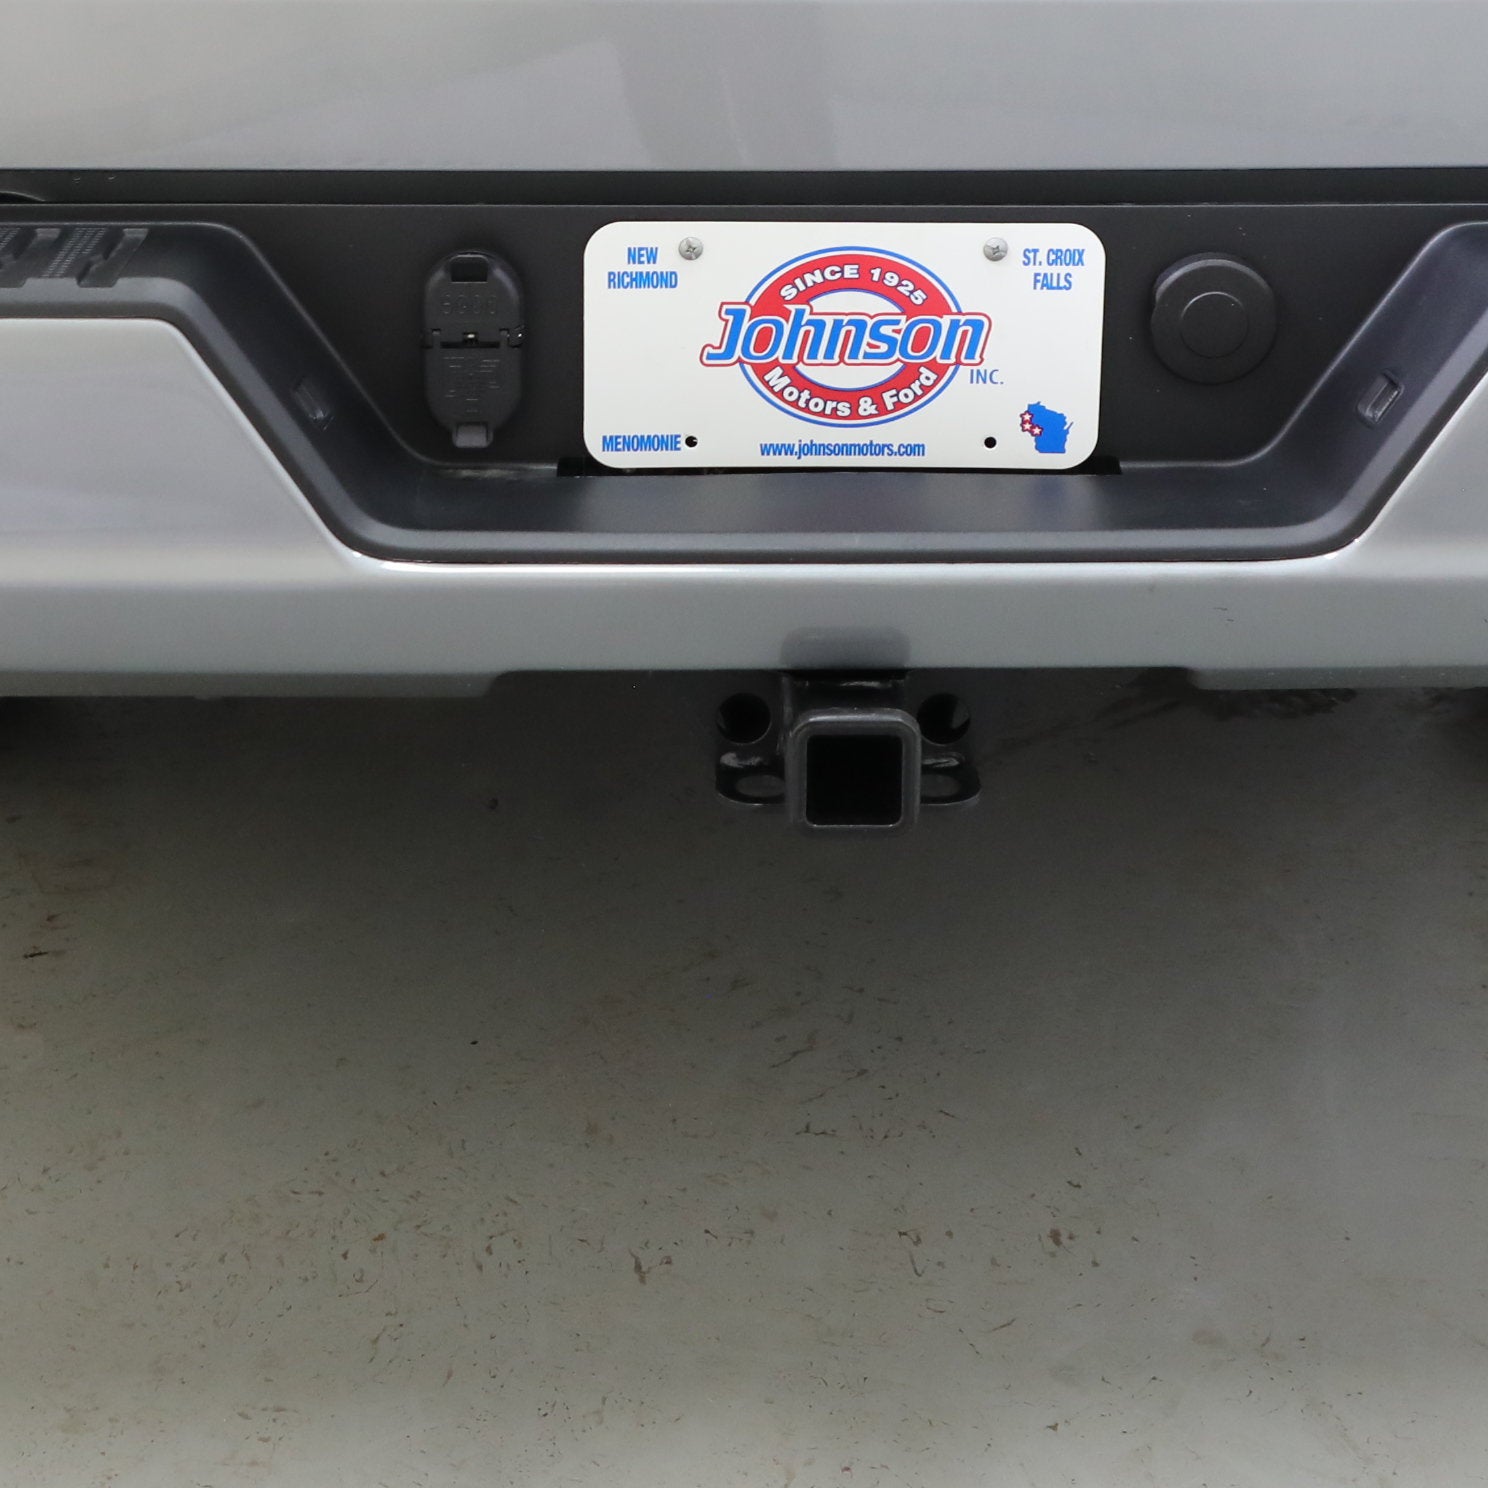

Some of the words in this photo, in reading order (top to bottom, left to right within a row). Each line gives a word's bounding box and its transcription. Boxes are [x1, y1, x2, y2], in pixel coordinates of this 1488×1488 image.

[627, 246, 659, 265] NEW
[1022, 248, 1043, 267] ST.
[1046, 248, 1086, 267] CROIX
[607, 270, 679, 289] RICHMOND
[779, 263, 860, 302] SINCE
[869, 266, 929, 306] 1925
[1032, 272, 1073, 291] FALLS
[702, 305, 989, 363] Johnson
[969, 368, 1005, 385] INC.
[763, 365, 852, 418] Motors
[857, 396, 879, 417] &
[882, 366, 939, 412] Ford
[602, 434, 682, 452] MENOMONIE
[759, 439, 926, 460] www.johnsonmotors.com
